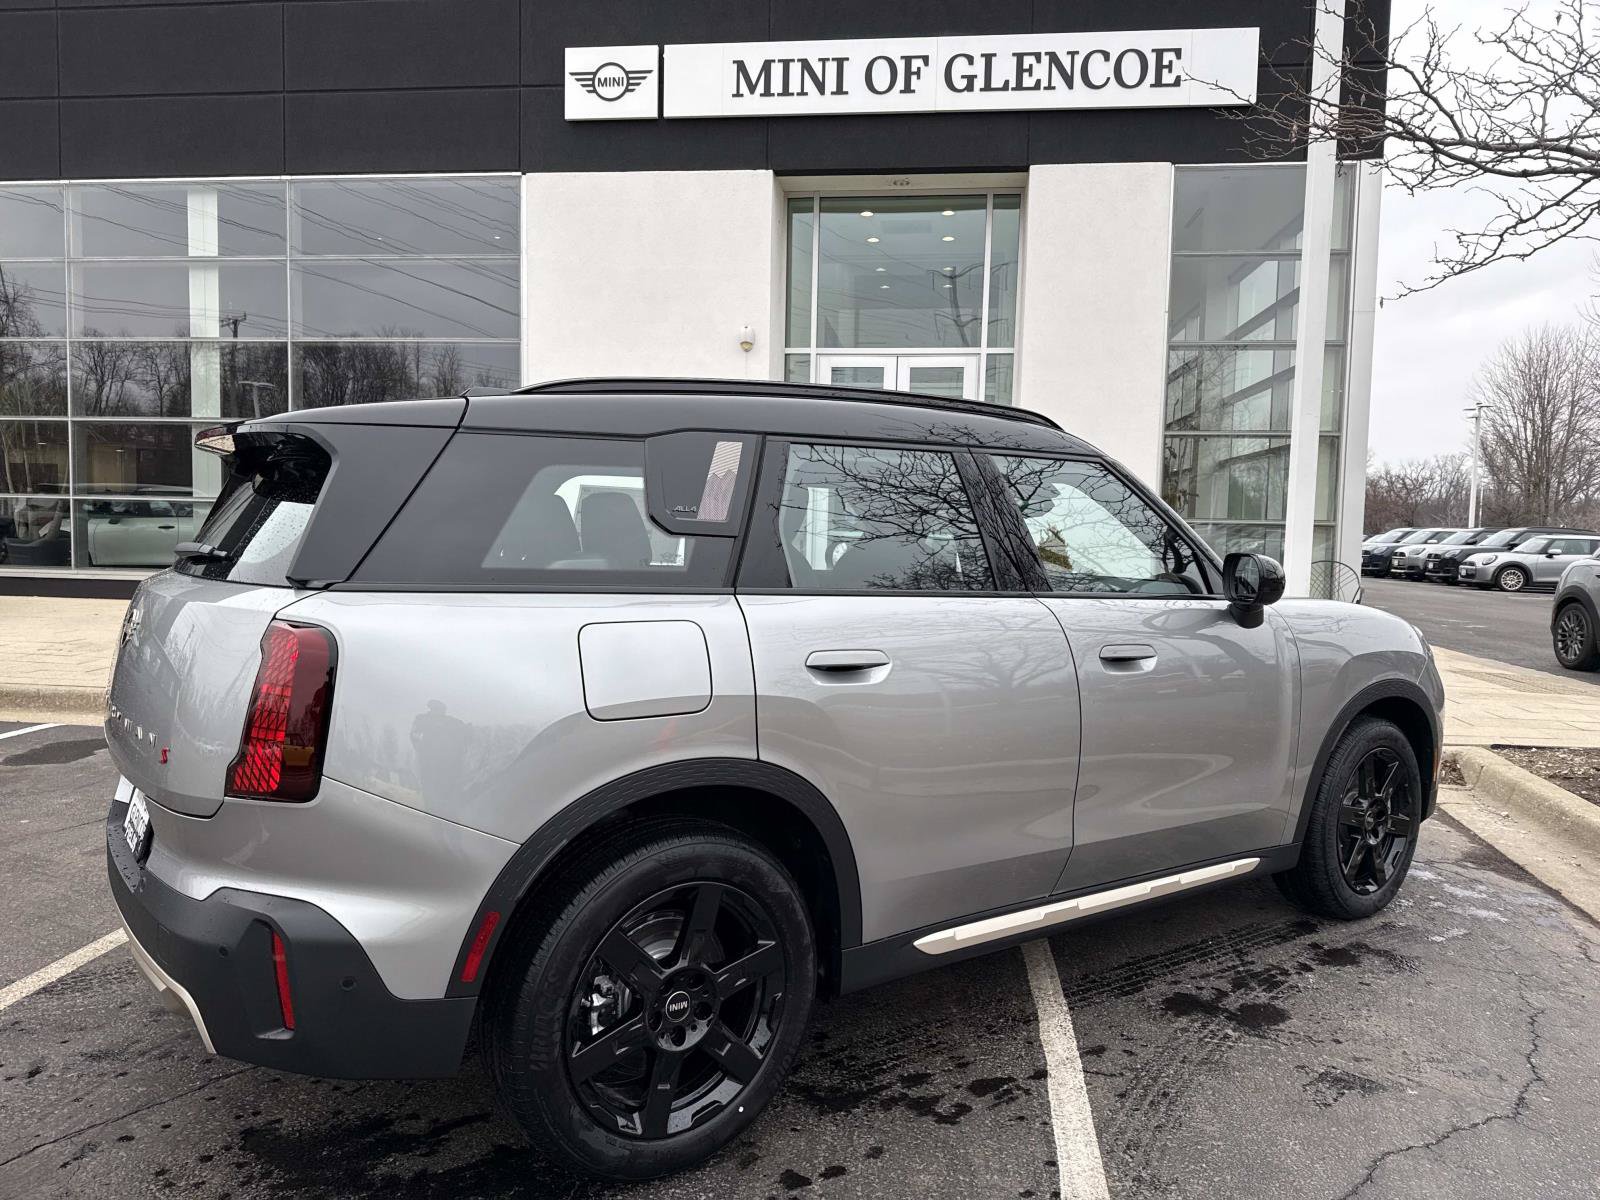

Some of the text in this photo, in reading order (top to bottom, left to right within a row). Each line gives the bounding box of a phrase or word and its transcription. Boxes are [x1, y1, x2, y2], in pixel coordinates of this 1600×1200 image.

[732, 48, 1182, 98] MINI OF GLENCOE
[597, 77, 624, 87] MINI
[669, 1001, 688, 1012] MINI
